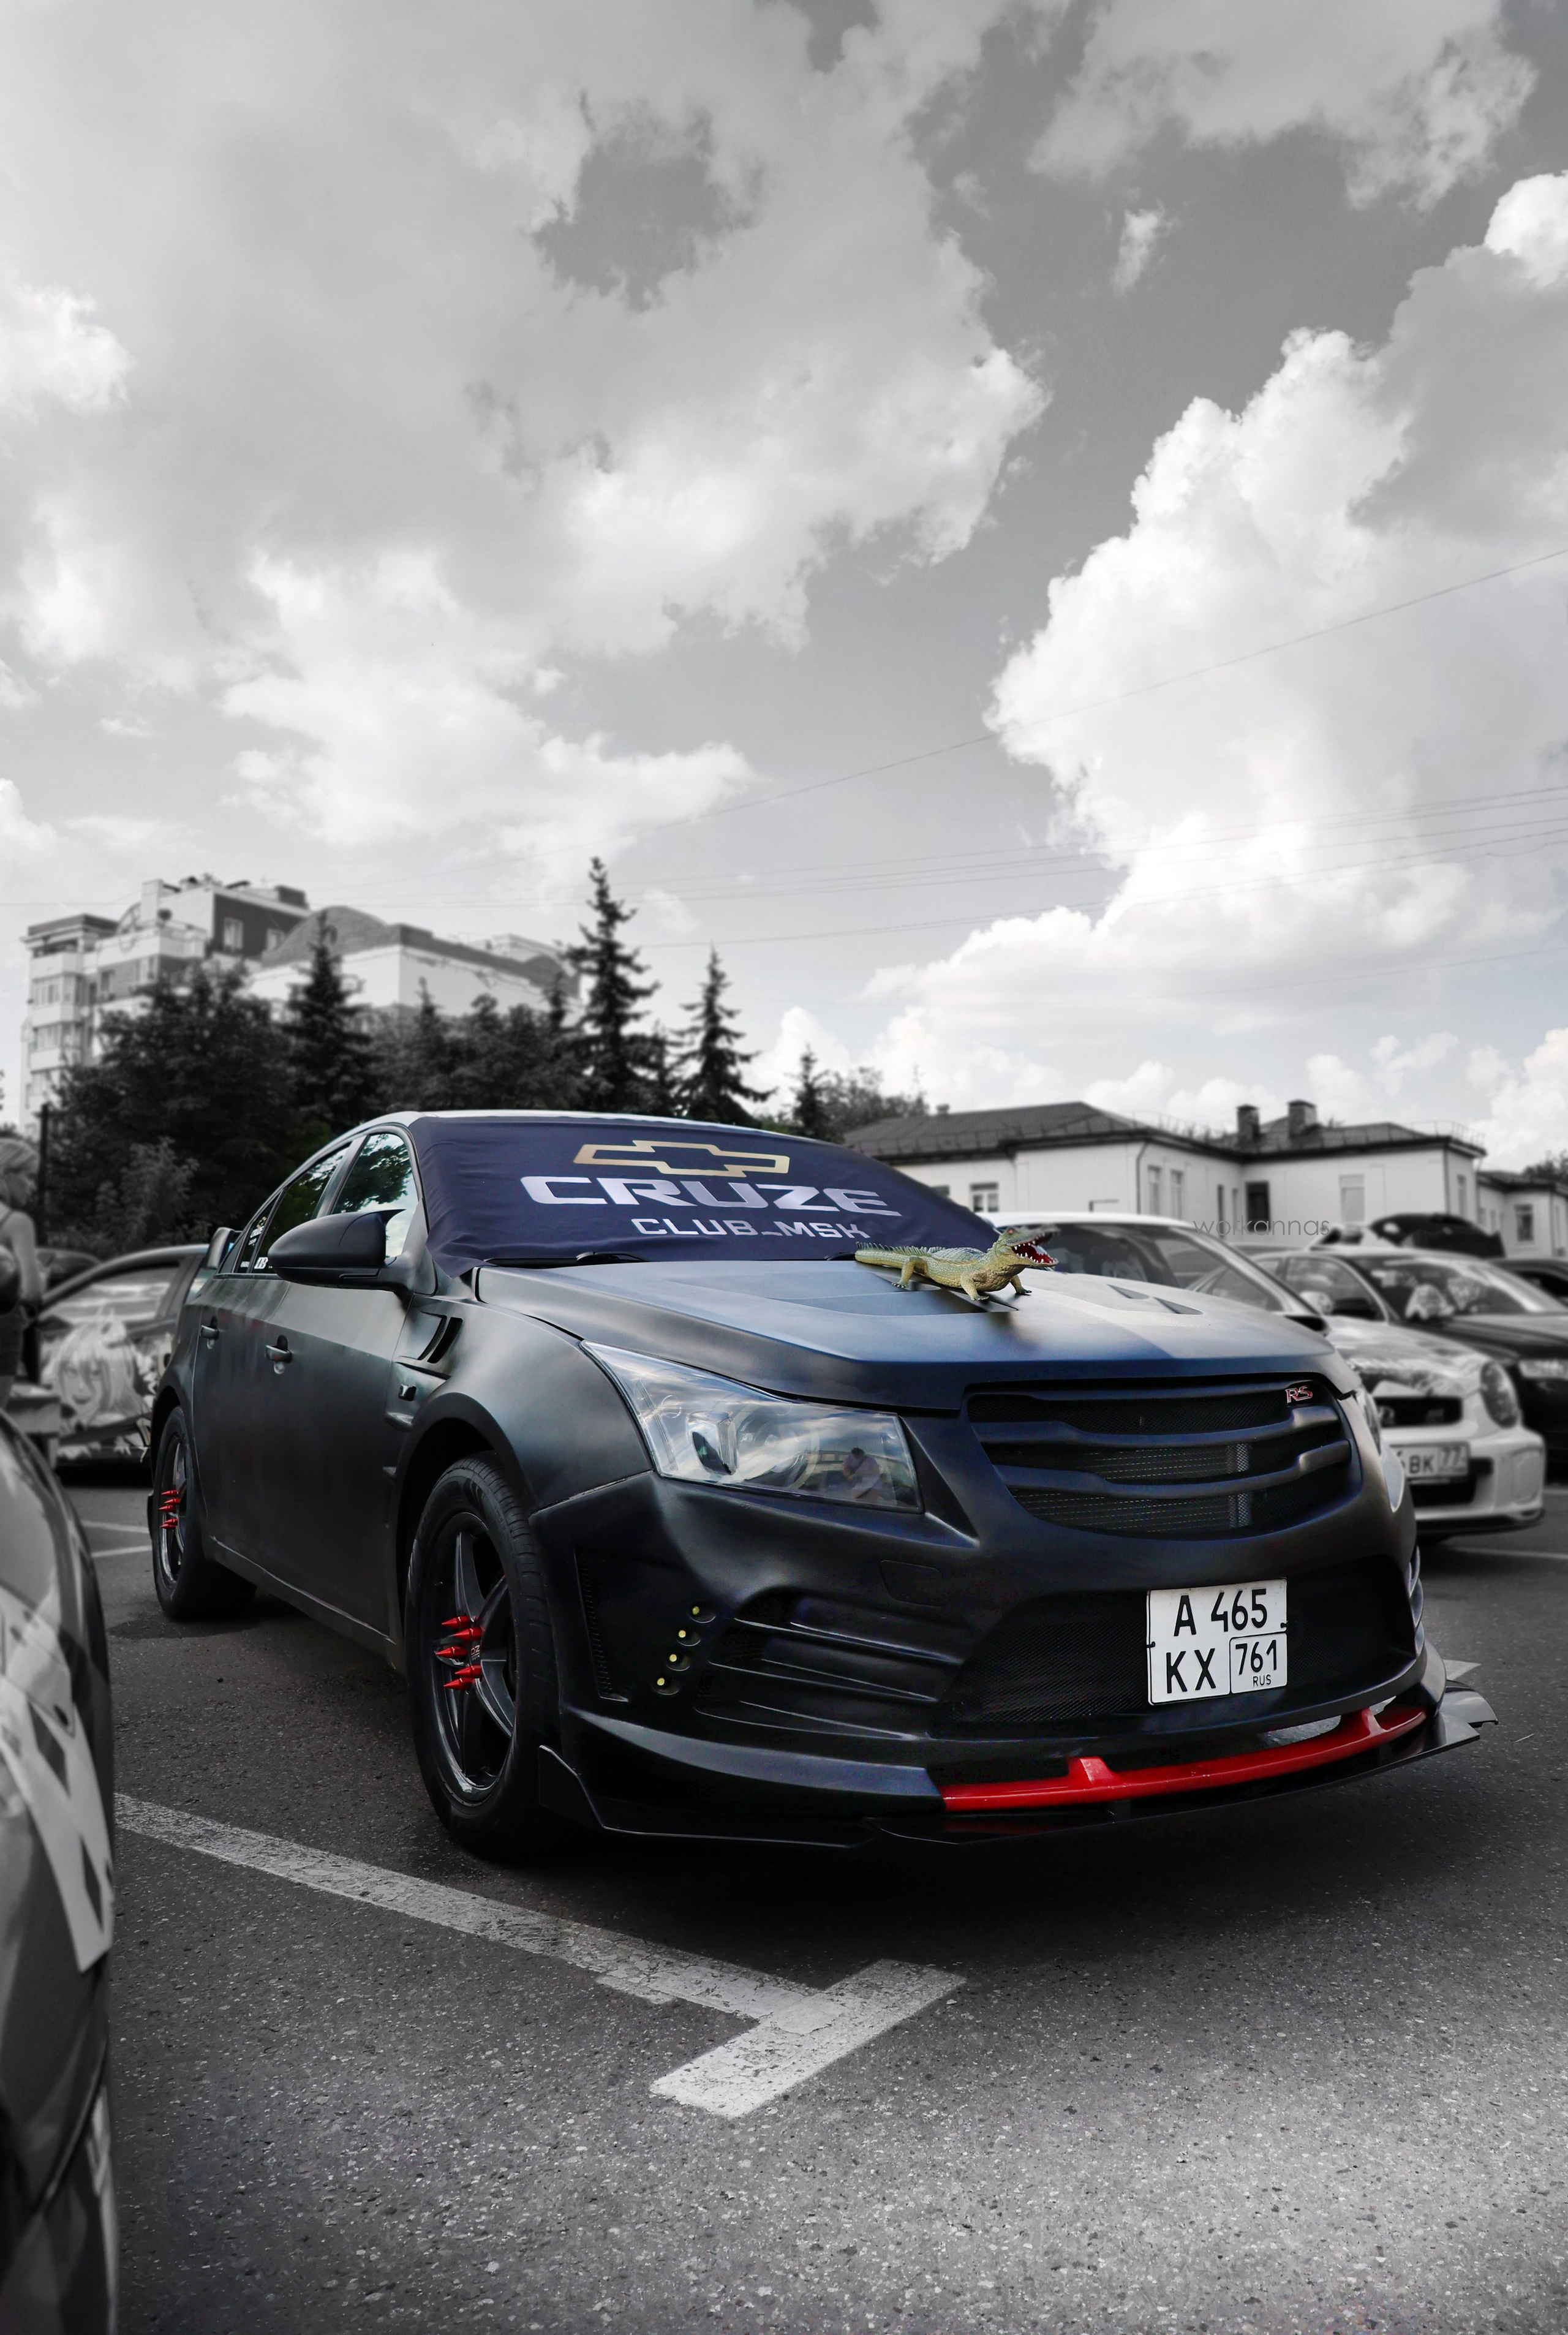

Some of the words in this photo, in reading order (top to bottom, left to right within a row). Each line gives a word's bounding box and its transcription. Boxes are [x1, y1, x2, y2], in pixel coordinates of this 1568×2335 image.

[521, 1176, 902, 1217] CRUZE
[631, 1218, 870, 1239] CLUB_MSK
[1284, 1385, 1313, 1403] RS
[1174, 1594, 1197, 1637] A
[1211, 1588, 1267, 1632] 465
[1166, 1648, 1216, 1694] KX
[1235, 1639, 1277, 1675] 761
[1253, 1674, 1272, 1687] RUS
